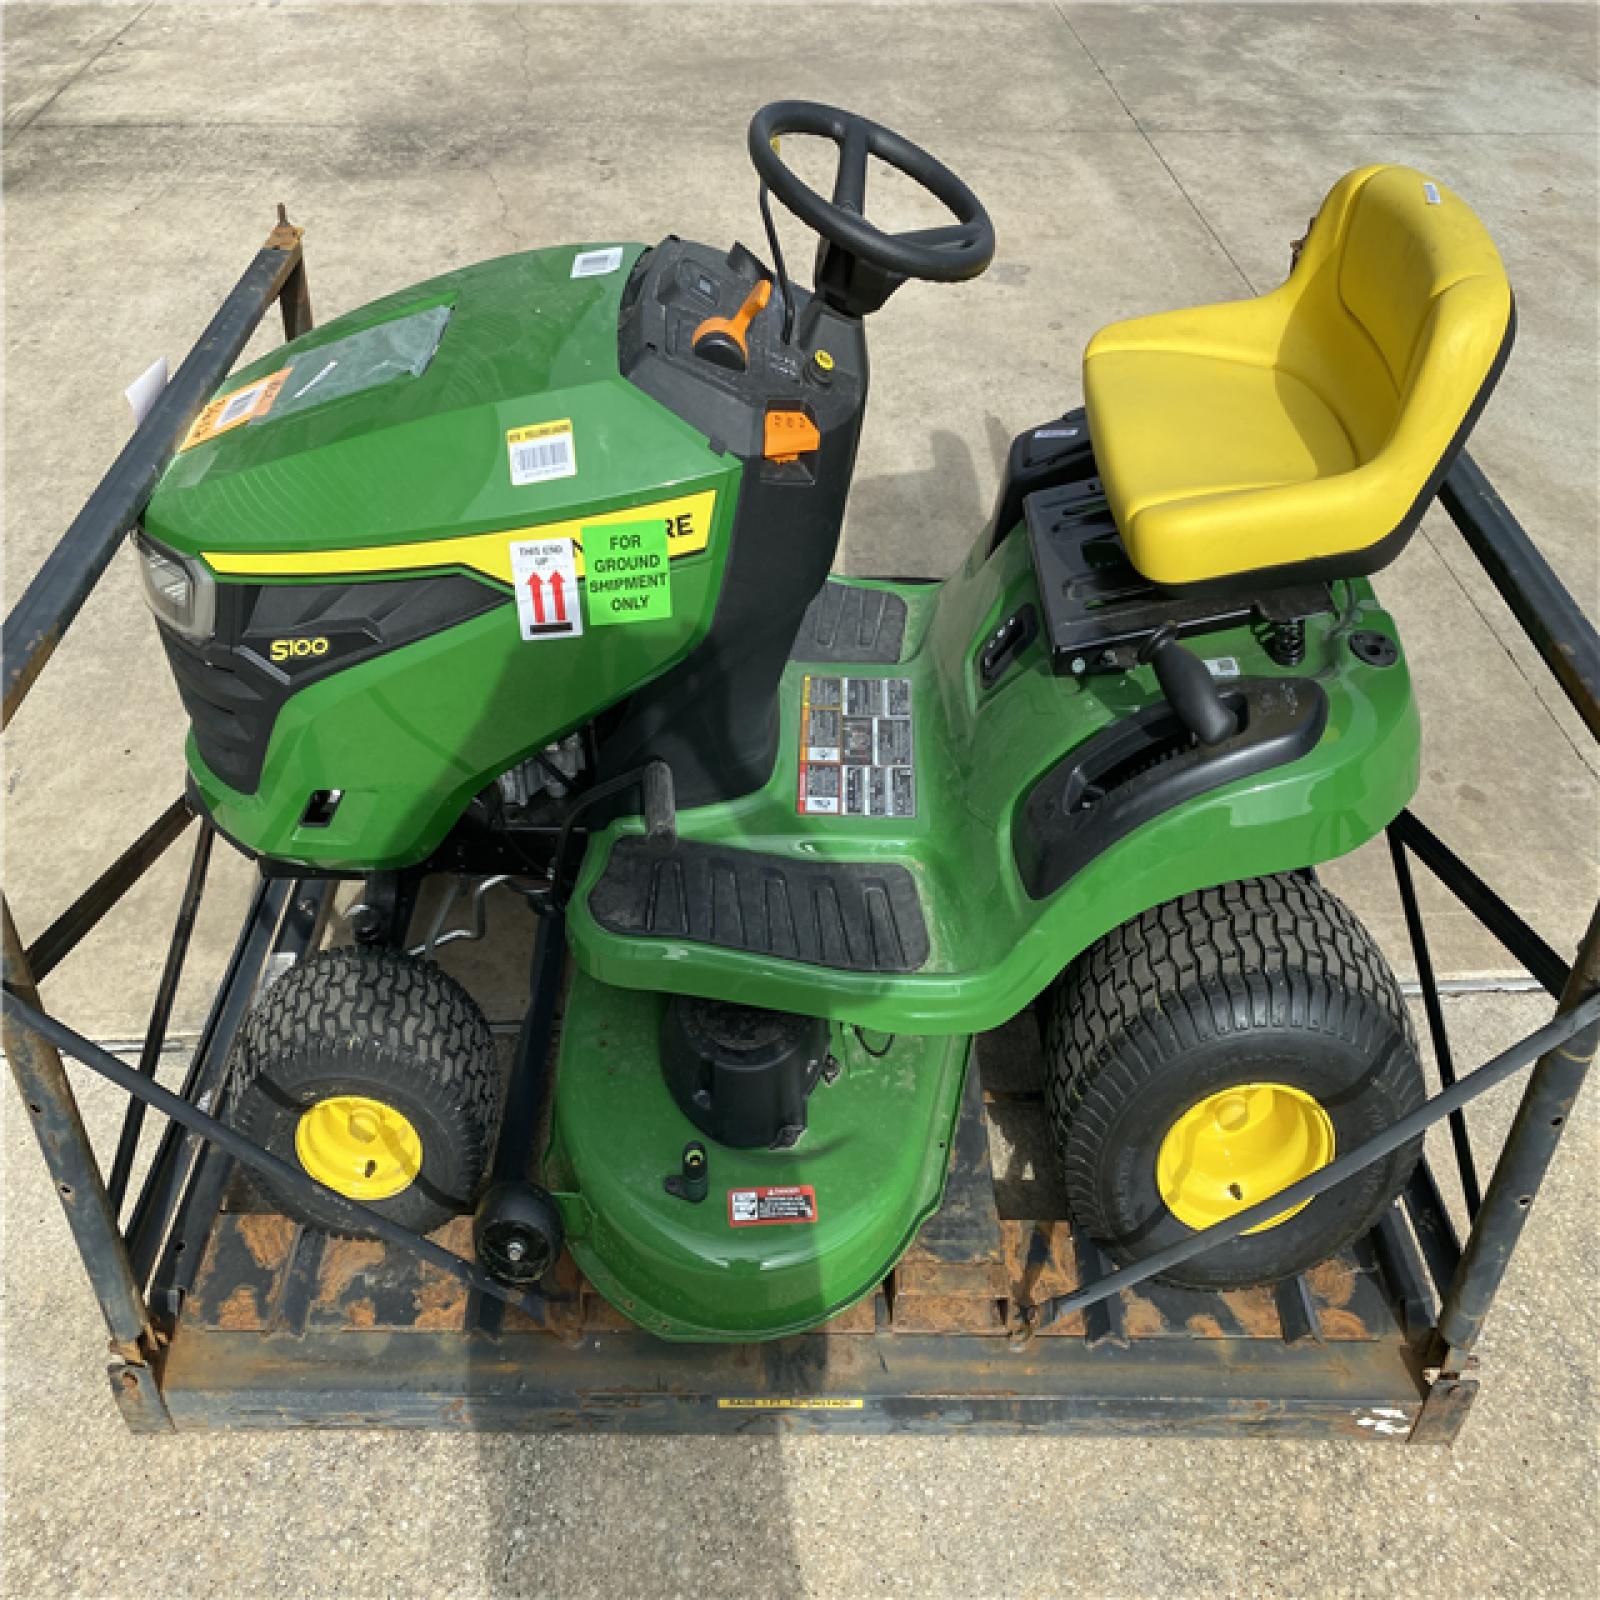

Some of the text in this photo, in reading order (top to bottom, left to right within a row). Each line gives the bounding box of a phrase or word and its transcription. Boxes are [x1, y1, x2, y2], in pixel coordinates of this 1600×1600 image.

[519, 546, 540, 556] THIS
[610, 534, 641, 551] FOR
[594, 554, 661, 573] GROUND
[590, 572, 667, 594] SHIPMENT
[611, 595, 649, 613] ONLY
[271, 637, 328, 661] S100
